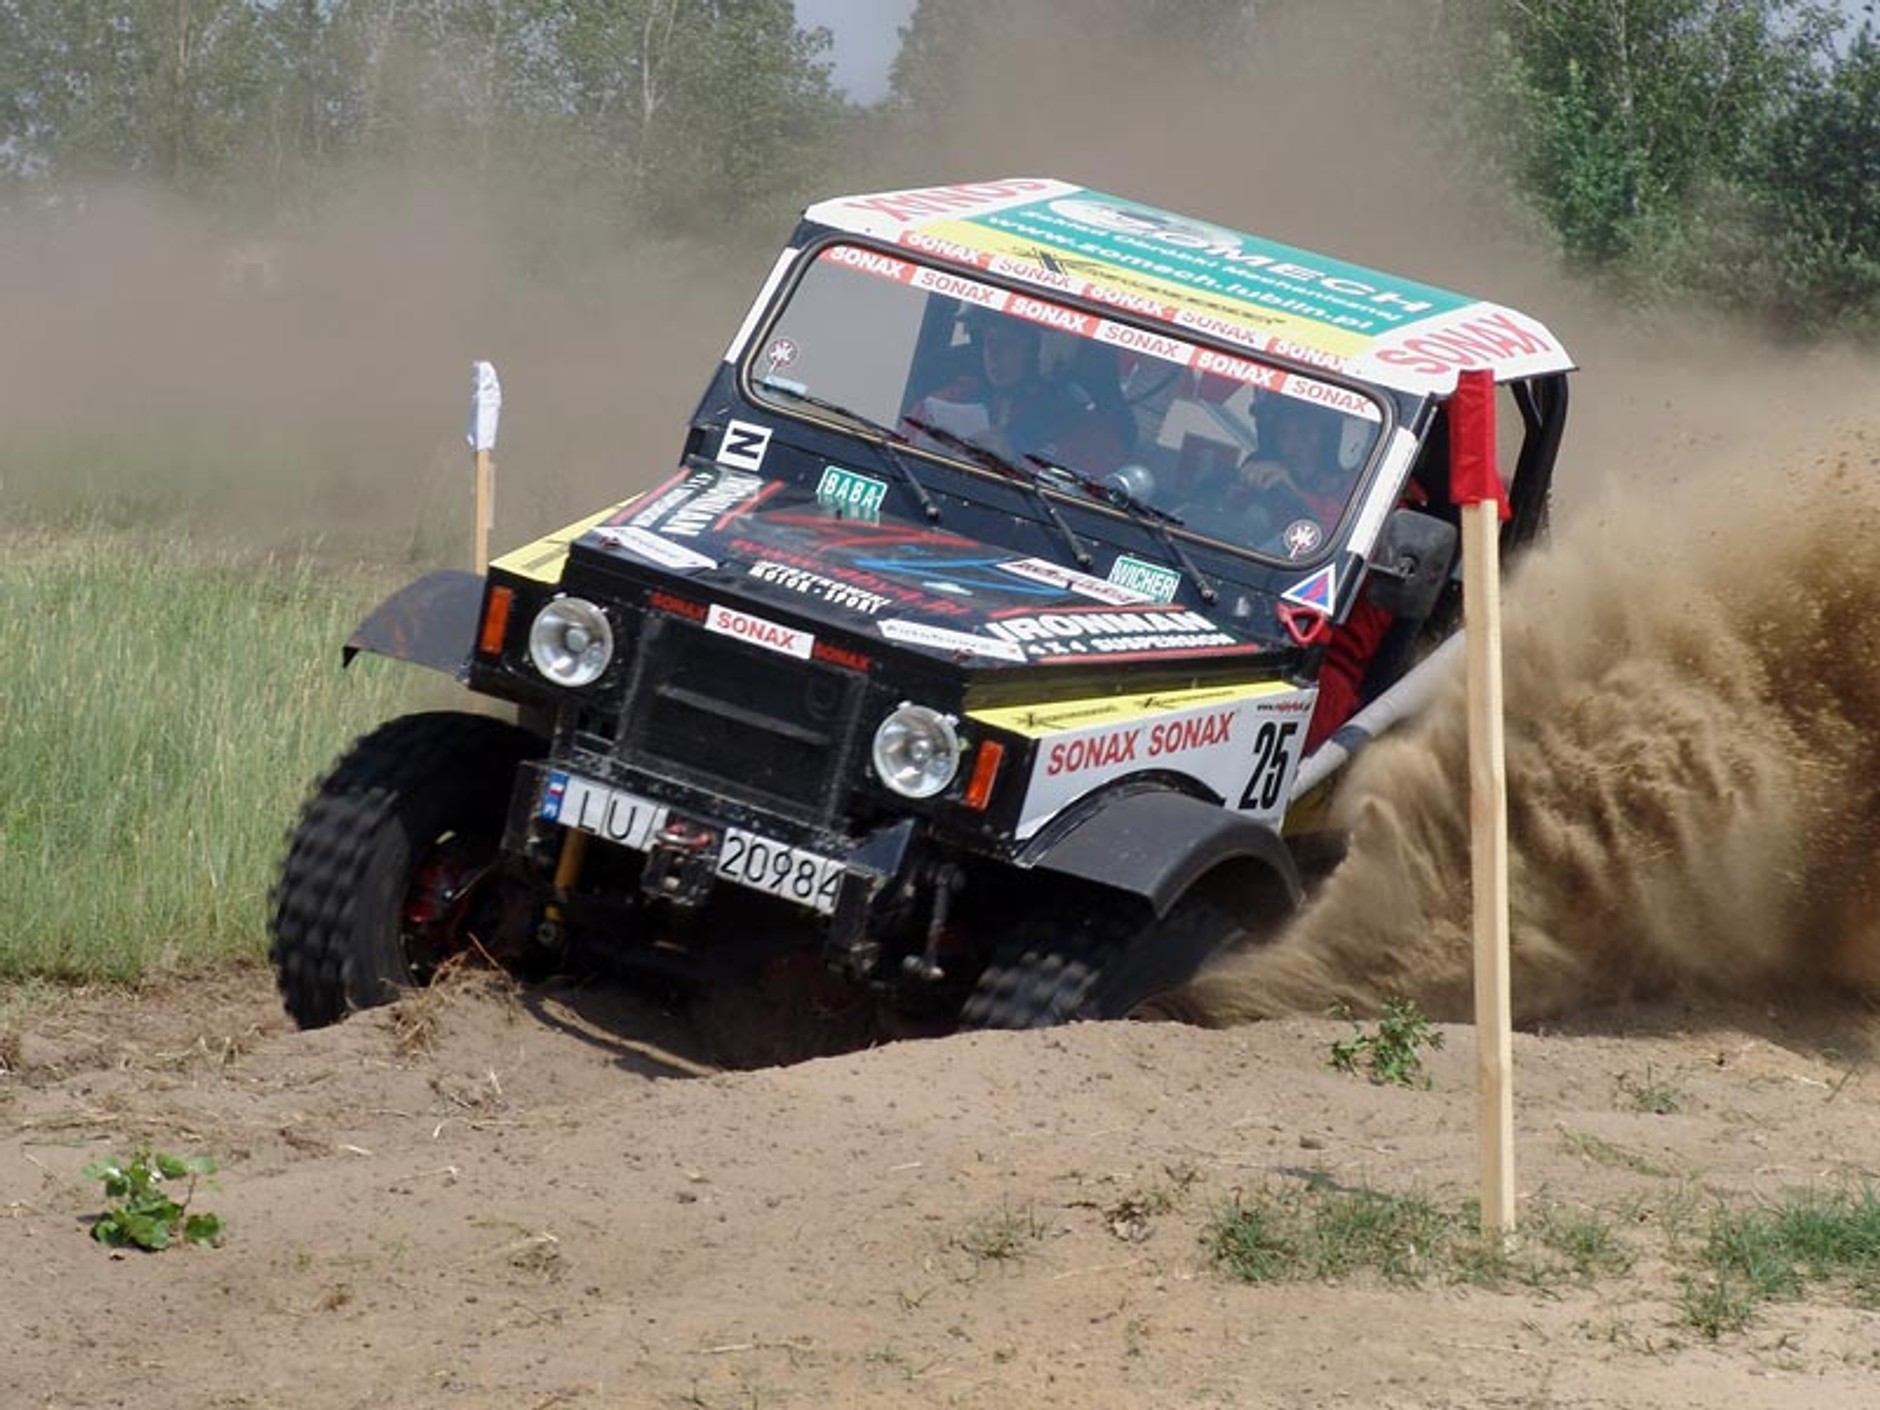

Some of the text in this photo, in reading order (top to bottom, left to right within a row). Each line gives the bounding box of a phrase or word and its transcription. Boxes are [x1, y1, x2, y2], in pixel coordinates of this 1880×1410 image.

[909, 232, 981, 265] SONAX
[1000, 257, 1073, 288] SONAX
[1091, 286, 1163, 316] SONAX
[1182, 310, 1255, 344] SONAX
[831, 244, 905, 279] SONAX
[921, 271, 996, 304] SONAX
[1012, 297, 1088, 332] SONAX
[1104, 325, 1181, 358] SONAX
[1198, 351, 1276, 386] SONAX
[1292, 379, 1371, 414] SONAX
[1374, 313, 1550, 376] SONAX
[717, 611, 796, 650] SONAX
[986, 611, 1218, 643] IRONMAN
[1048, 711, 1235, 775] SONAX SONAX
[1238, 721, 1299, 810] 25
[578, 789, 847, 911] LU 20984
